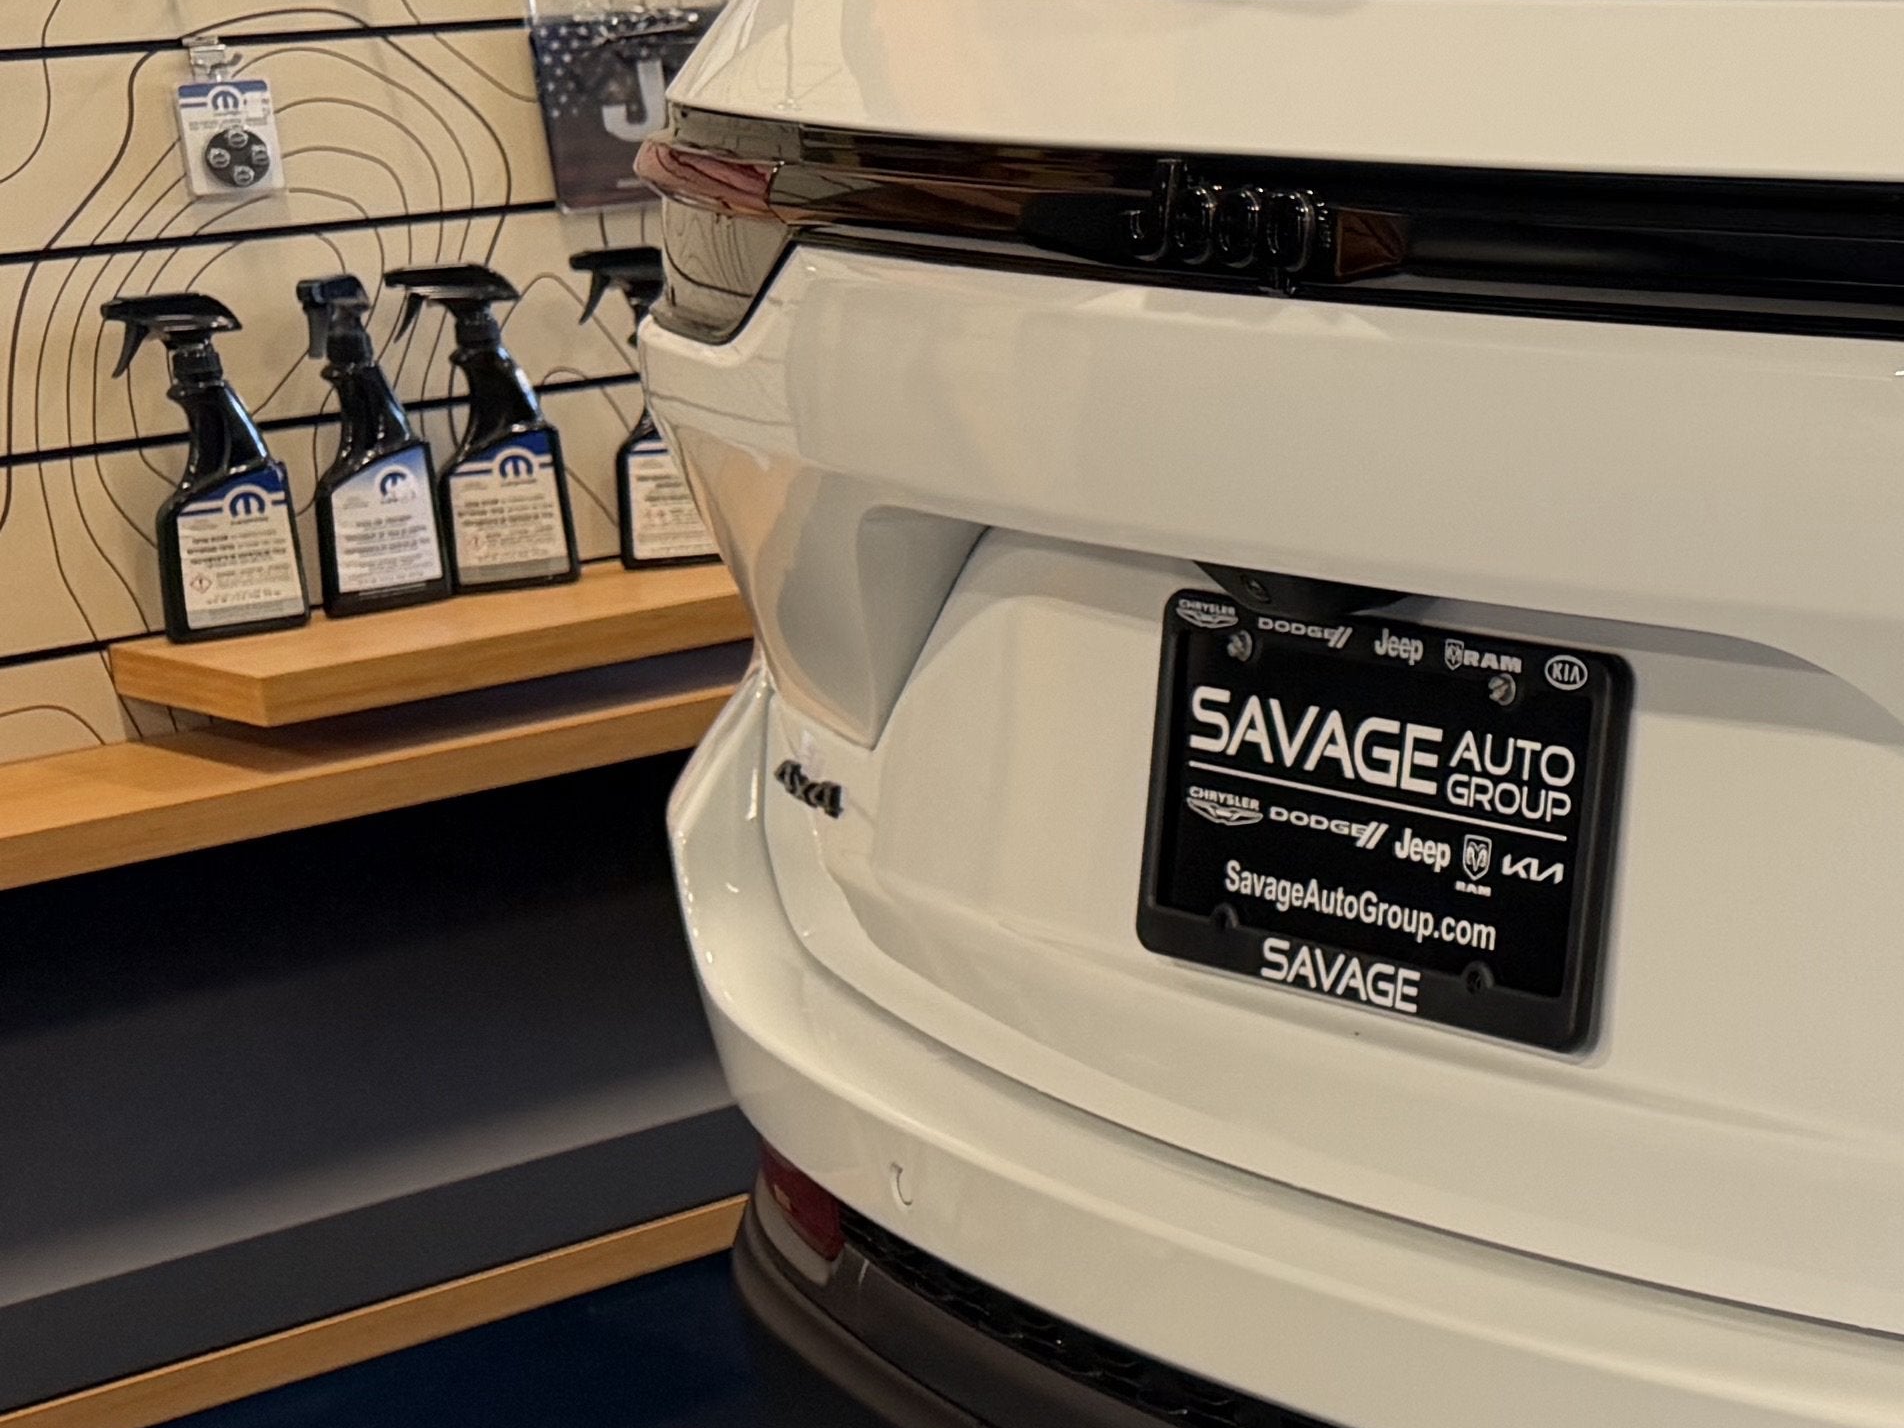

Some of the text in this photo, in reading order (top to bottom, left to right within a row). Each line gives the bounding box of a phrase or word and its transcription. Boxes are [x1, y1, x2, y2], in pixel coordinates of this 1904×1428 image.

[1178, 598, 1236, 616] CHRYSLER
[1374, 628, 1424, 666] Jeep
[1463, 649, 1523, 674] RAM
[1188, 685, 1576, 795] SAVAGE AUTO
[1188, 785, 1260, 811] CHRYSLER
[1269, 806, 1368, 838] DODGE
[1394, 827, 1451, 873] Jeep
[1446, 773, 1572, 823] GROUP
[1224, 860, 1497, 951] SavageAutoGroup.com
[1260, 937, 1421, 1013] SAVAGE
